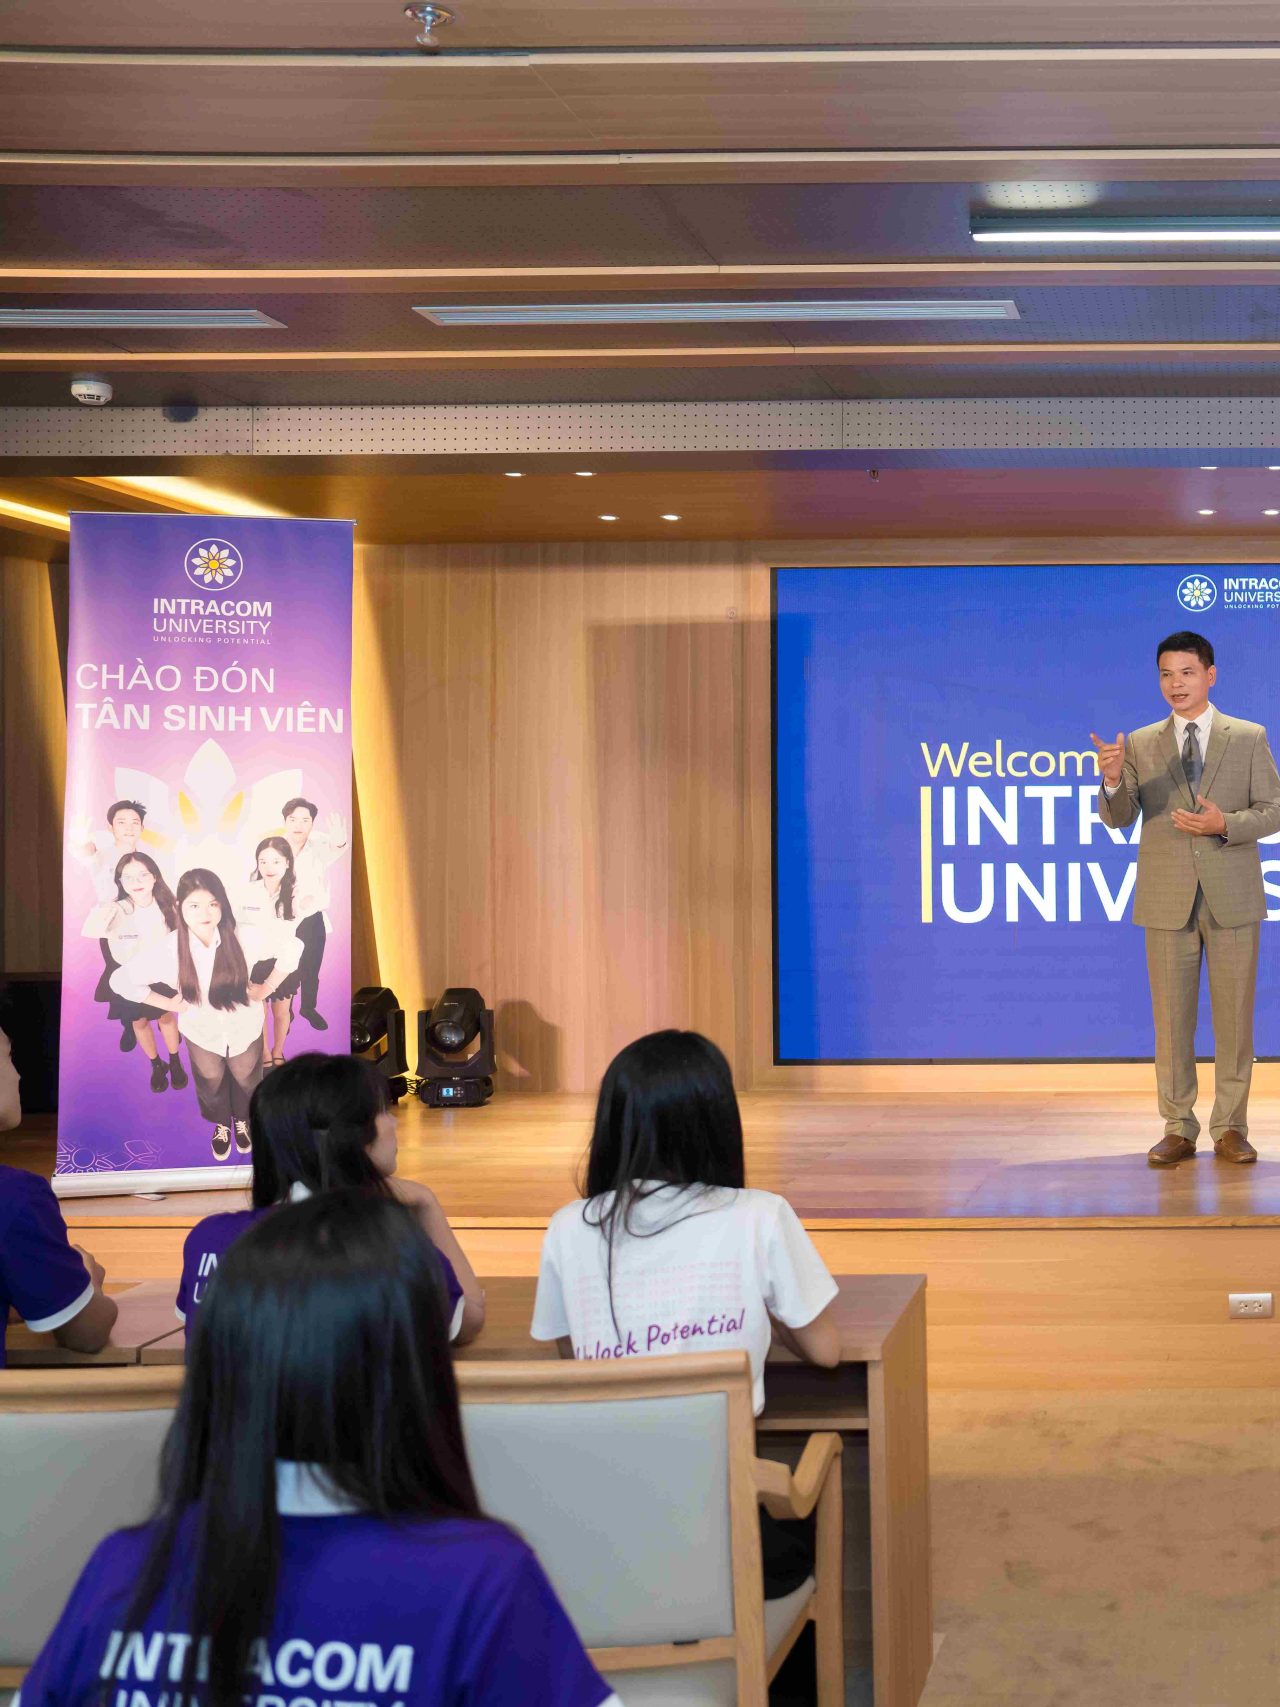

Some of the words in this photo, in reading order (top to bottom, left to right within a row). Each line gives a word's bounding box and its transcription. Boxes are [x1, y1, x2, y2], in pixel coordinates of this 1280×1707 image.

[153, 598, 272, 617] INTRACOM
[153, 618, 271, 635] UNIVERSITY
[217, 637, 271, 645] POTENTIAL
[75, 658, 181, 692] CHÀO
[193, 660, 275, 693] ĐÓN
[75, 697, 150, 730] TÂN
[163, 704, 250, 732] SINH
[259, 701, 344, 734] VIÊN
[920, 739, 1100, 778] Welcom
[646, 1308, 746, 1351] Potential
[99, 1630, 414, 1693] INTACOM
